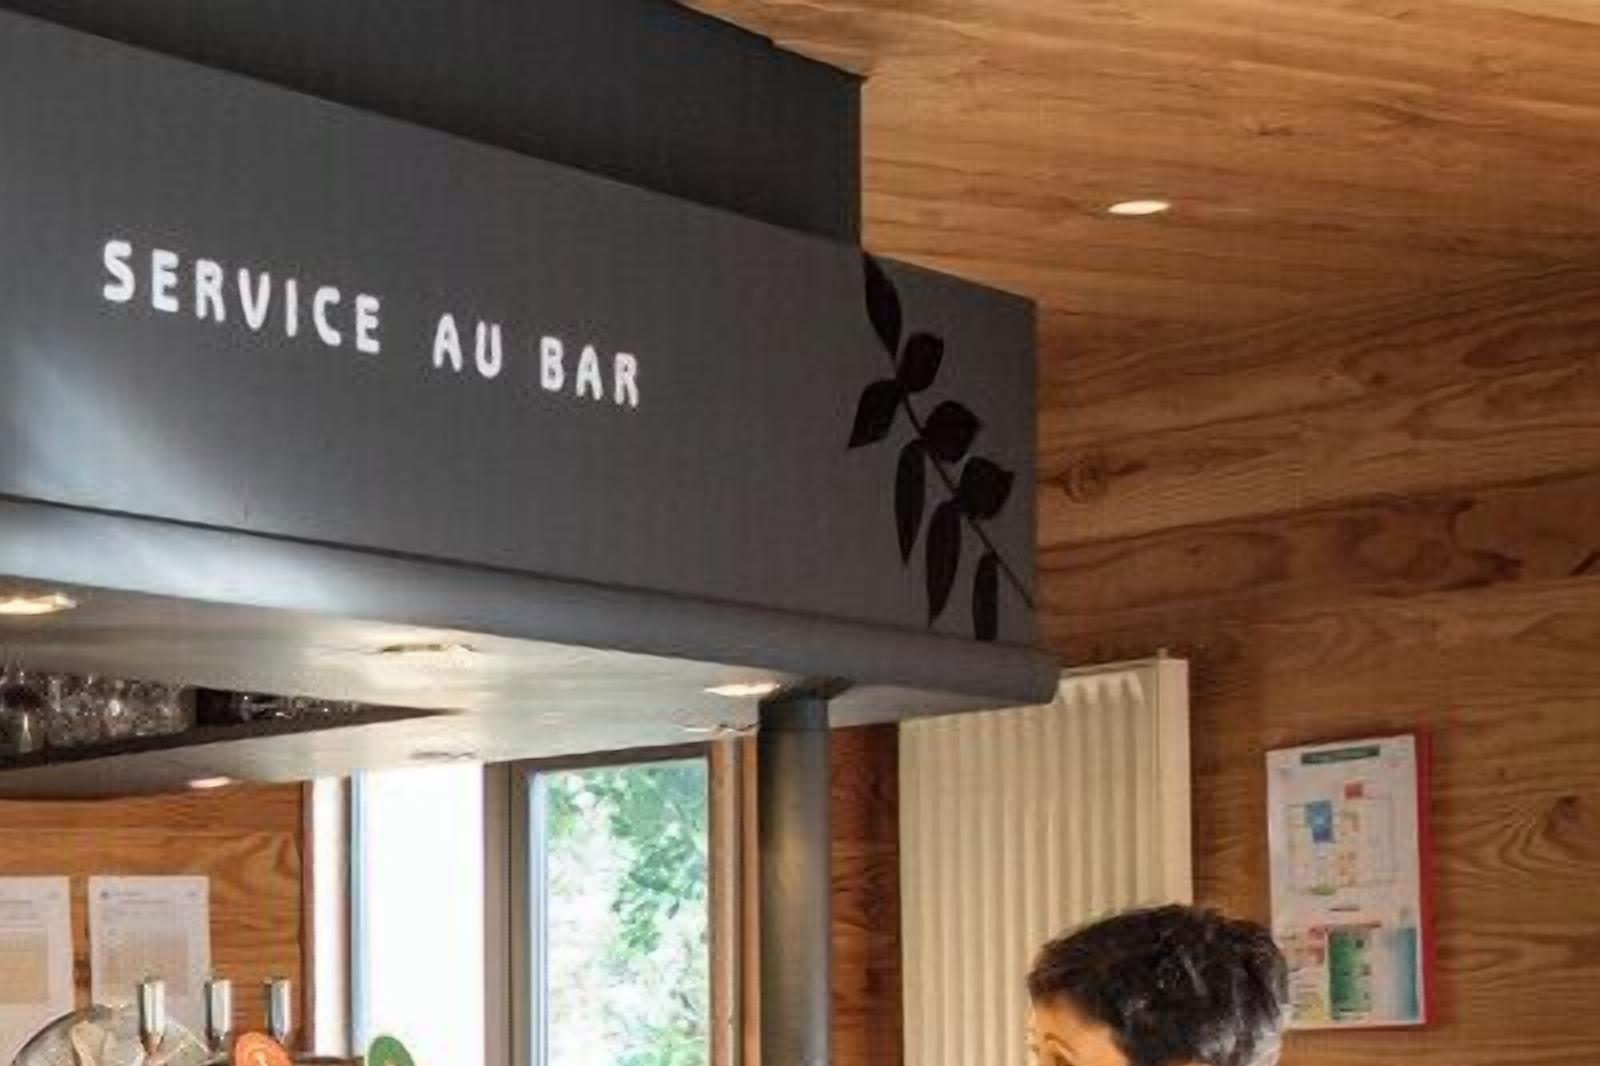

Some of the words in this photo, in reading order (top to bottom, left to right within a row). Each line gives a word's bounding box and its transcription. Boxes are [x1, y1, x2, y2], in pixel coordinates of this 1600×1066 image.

[102, 239, 381, 355] SERVICE
[432, 313, 503, 379] AU
[540, 335, 639, 408] BAR
